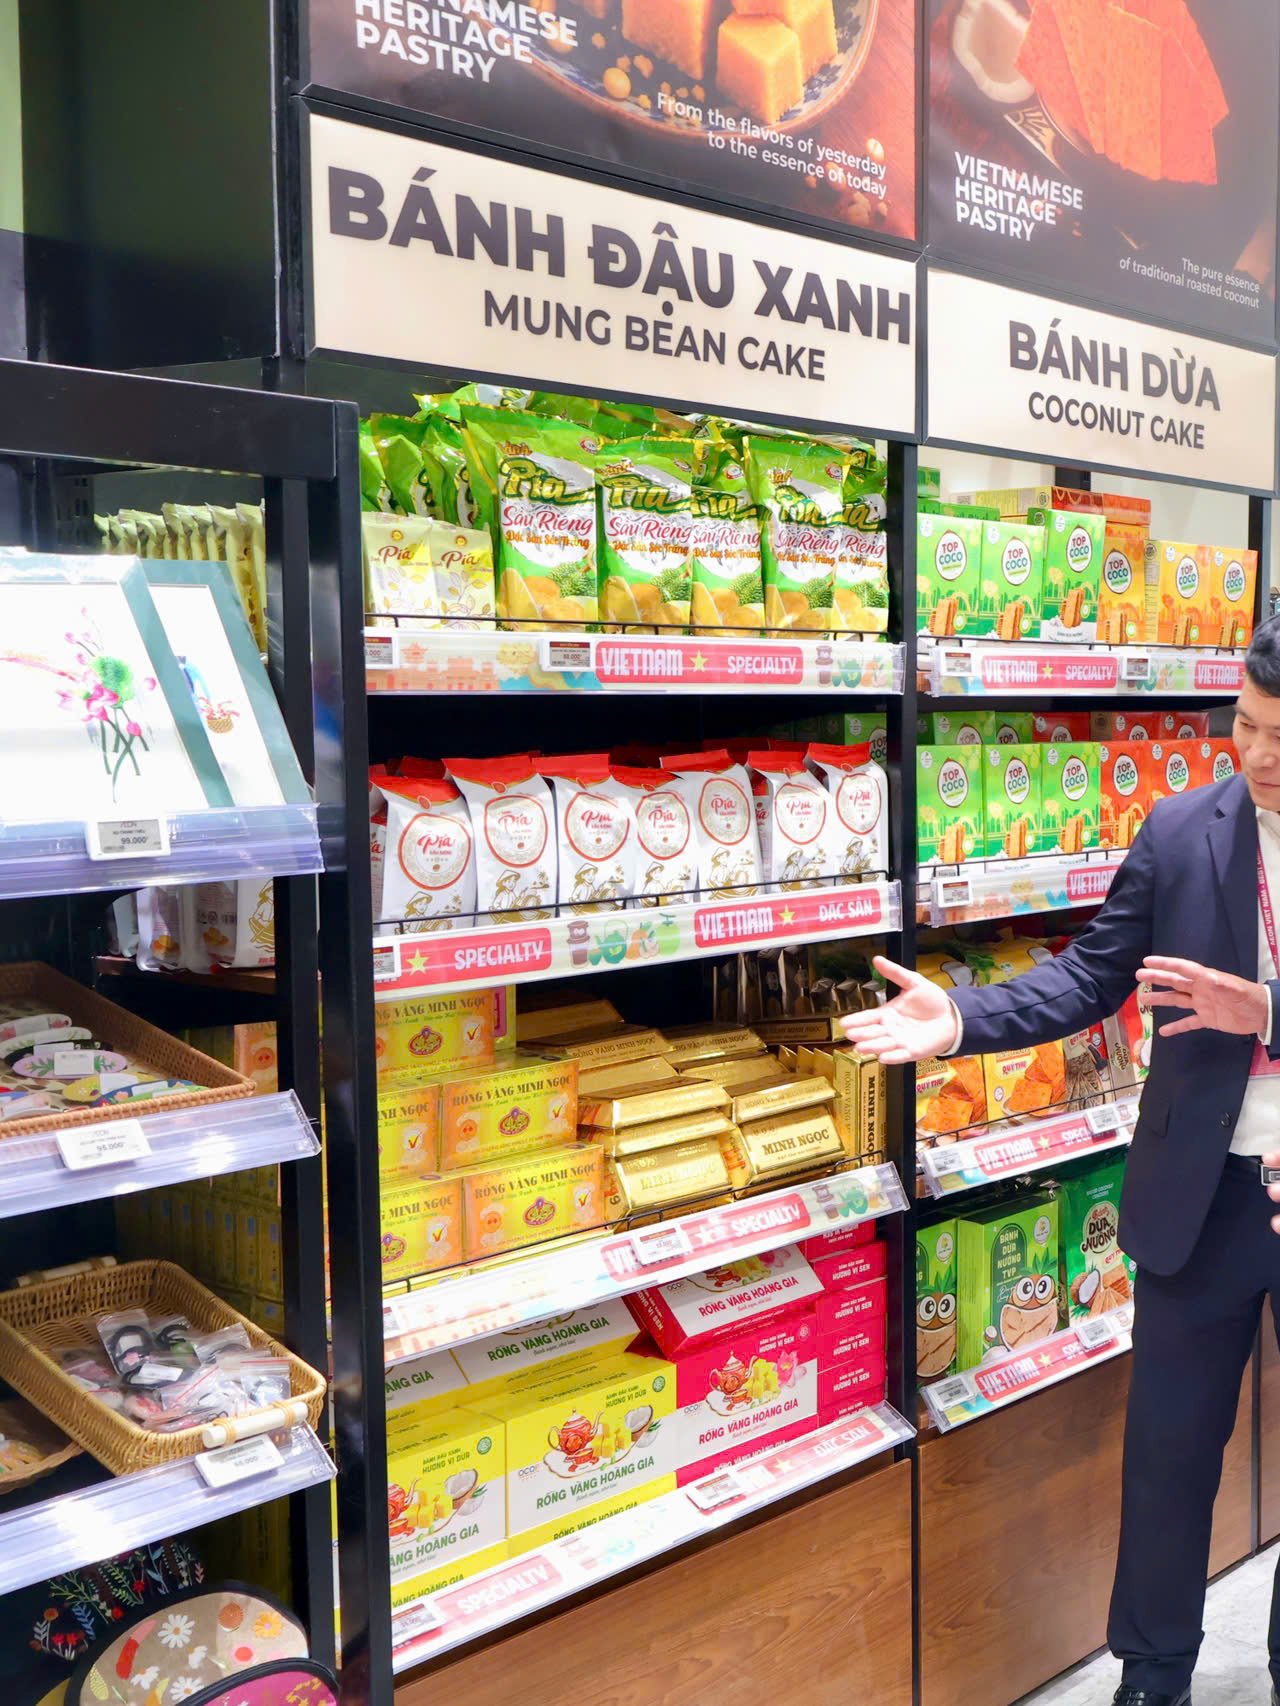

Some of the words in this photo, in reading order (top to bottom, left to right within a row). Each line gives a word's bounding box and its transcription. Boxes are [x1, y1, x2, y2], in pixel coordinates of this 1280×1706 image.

[422, 0, 578, 47] AMESE
[355, 0, 533, 64] HERITAGE
[356, 19, 497, 83] PASTRY
[657, 92, 703, 121] From
[708, 108, 736, 131] the
[740, 117, 794, 148] flavors
[798, 137, 814, 154] of
[816, 145, 888, 181] yesterday
[708, 130, 725, 149] to
[730, 137, 758, 159] the
[762, 151, 824, 178] essence
[828, 165, 845, 183] of
[847, 171, 887, 199] today
[955, 151, 1084, 212] VIETNAMESE
[955, 178, 1057, 226] HERITAGE
[956, 201, 1035, 242] PASTRY
[328, 165, 566, 278] BÁNH
[588, 221, 735, 316] ĐẬU
[753, 259, 911, 346] XANH
[1119, 257, 1131, 270] of
[1132, 260, 1185, 287] traditional
[1186, 276, 1222, 298] roasted
[1223, 288, 1260, 309] coconut
[1181, 257, 1200, 276] The
[1202, 267, 1224, 285] pure
[1225, 273, 1260, 295] essence
[484, 290, 612, 346] MUNG
[625, 316, 726, 366] BEAN
[738, 338, 826, 381] CAKE
[1009, 318, 1129, 391] BÁNH
[1141, 347, 1221, 411] DỪA
[1028, 391, 1145, 438] COCONUT
[1151, 416, 1205, 450] CAKE
[942, 541, 959, 553] TOP
[1071, 536, 1086, 548] TOP
[1007, 548, 1024, 559] TOP
[1068, 543, 1090, 556] COCO
[938, 551, 963, 564] COCO
[1005, 557, 1028, 570] COCO
[1108, 559, 1124, 570] TOP
[1106, 568, 1129, 581] COCO
[1180, 564, 1194, 575] TOP
[1228, 568, 1241, 580] TOP
[1178, 573, 1197, 586] COCO
[1225, 577, 1243, 589] COCO
[601, 647, 684, 677] VIETNAM
[984, 659, 1038, 683] VIETNAM
[1198, 663, 1239, 686] VIETNAM
[1066, 764, 1081, 776] TOP
[1116, 762, 1131, 774] TOP
[1169, 760, 1183, 771] TOP
[1216, 758, 1229, 769] TOP
[943, 768, 960, 780] TOP
[1008, 766, 1023, 778] TOP
[1064, 772, 1086, 785] COCO
[1115, 770, 1136, 785] COCO
[1167, 767, 1187, 781] COCO
[1214, 766, 1235, 779] COCO
[941, 777, 965, 790] COCO
[1007, 775, 1028, 789] COCO
[698, 905, 774, 941] VIETNAM
[867, 1075, 876, 1118] MINH
[763, 1140, 796, 1156] MINH
[798, 1128, 830, 1147] NGỌC
[977, 1136, 1038, 1171] VIETNAM
[783, 1276, 800, 1288] GIA
[590, 1316, 610, 1329] GIA
[412, 1369, 434, 1386] GIA
[979, 1356, 1041, 1397] VIETNAM
[783, 1398, 799, 1412] GIA
[637, 1456, 655, 1470] GIA
[459, 1523, 480, 1539] GIA
